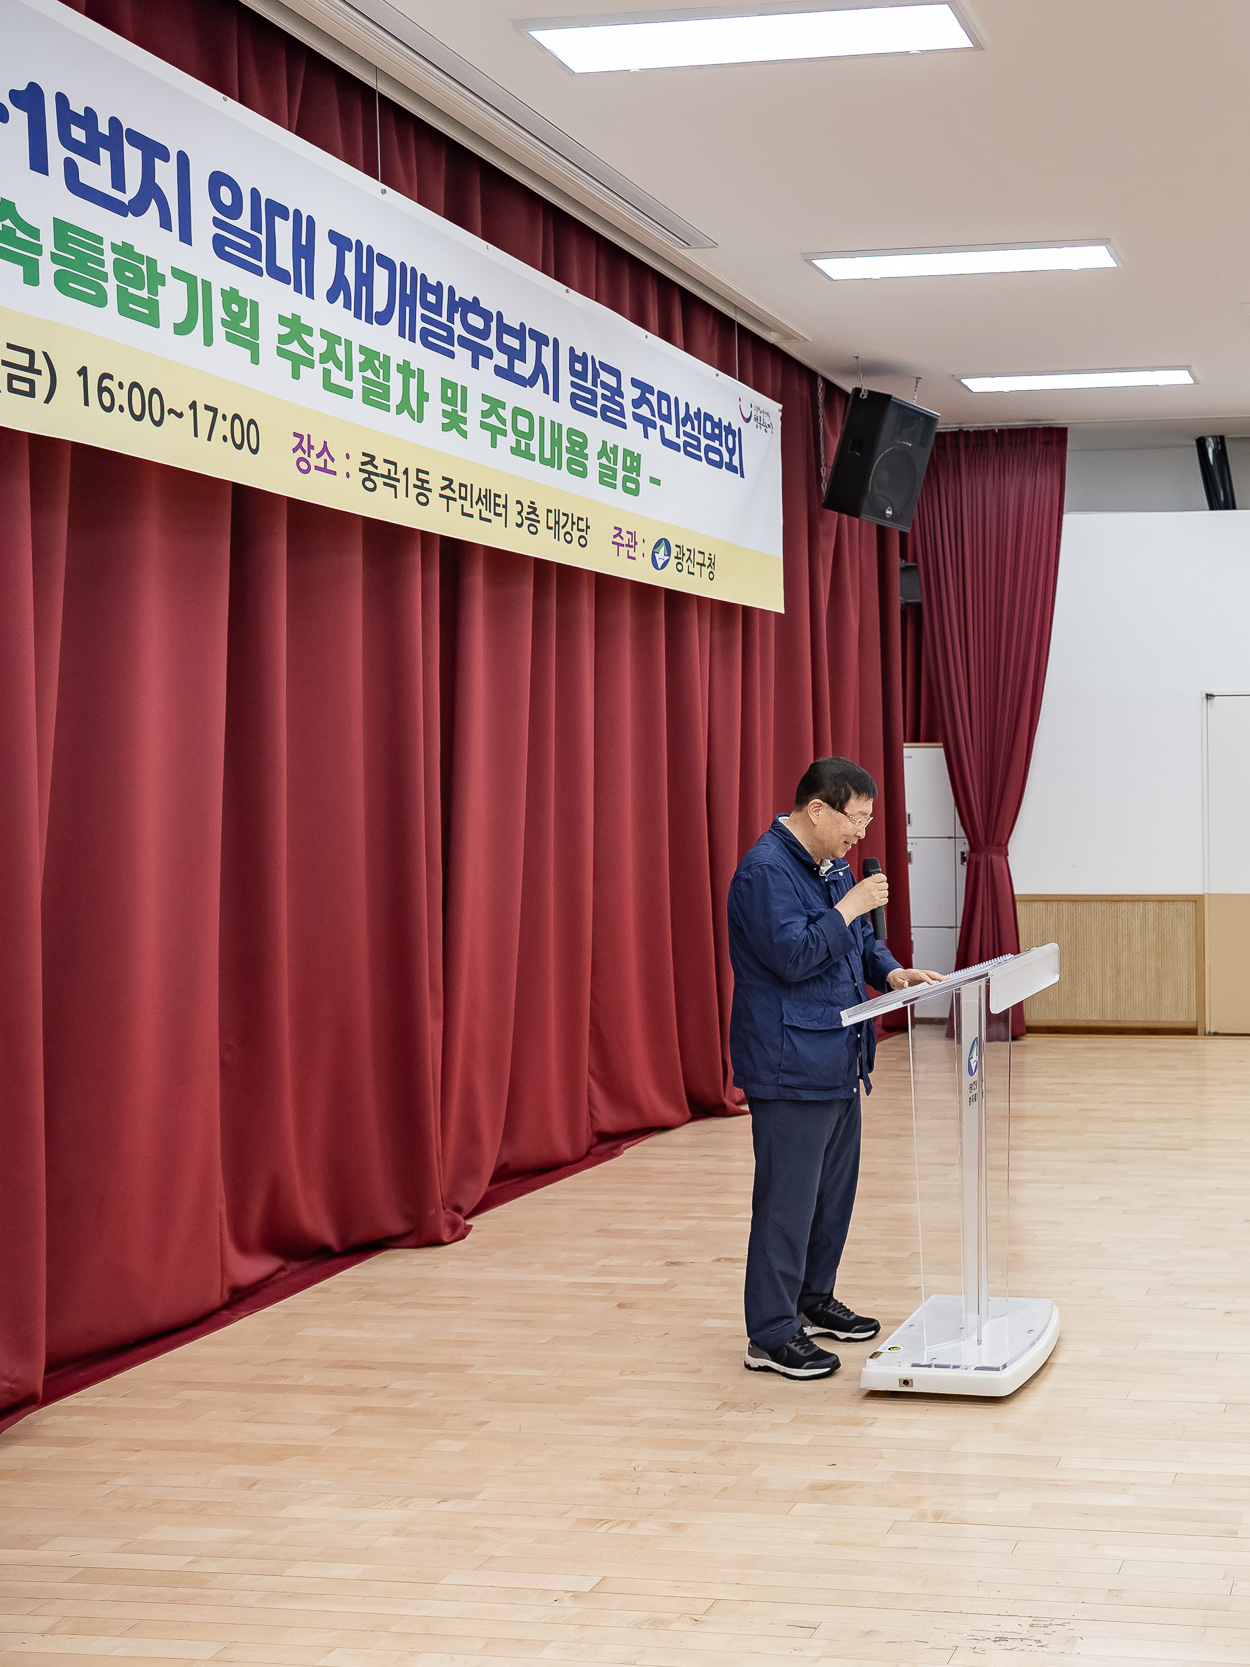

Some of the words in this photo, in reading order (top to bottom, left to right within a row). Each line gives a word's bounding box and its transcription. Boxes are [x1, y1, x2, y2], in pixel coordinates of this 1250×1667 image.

[0, 197, 260, 366] 속통합기획
[276, 313, 429, 424] 추진절차
[440, 377, 468, 439] 및
[479, 393, 589, 479] 주요내용
[597, 440, 642, 497] 설명
[76, 365, 261, 455] 16:00~17:00
[358, 451, 433, 507] 중곡1동
[438, 476, 508, 528] 주민센터
[515, 500, 541, 536] 3층
[546, 508, 591, 548] 대강당
[673, 544, 716, 581] 광진구청
[208, 170, 316, 300] 일대
[326, 229, 559, 403] 재개발후보지
[569, 346, 627, 430] 발굴
[630, 377, 744, 478] 주민설명회
